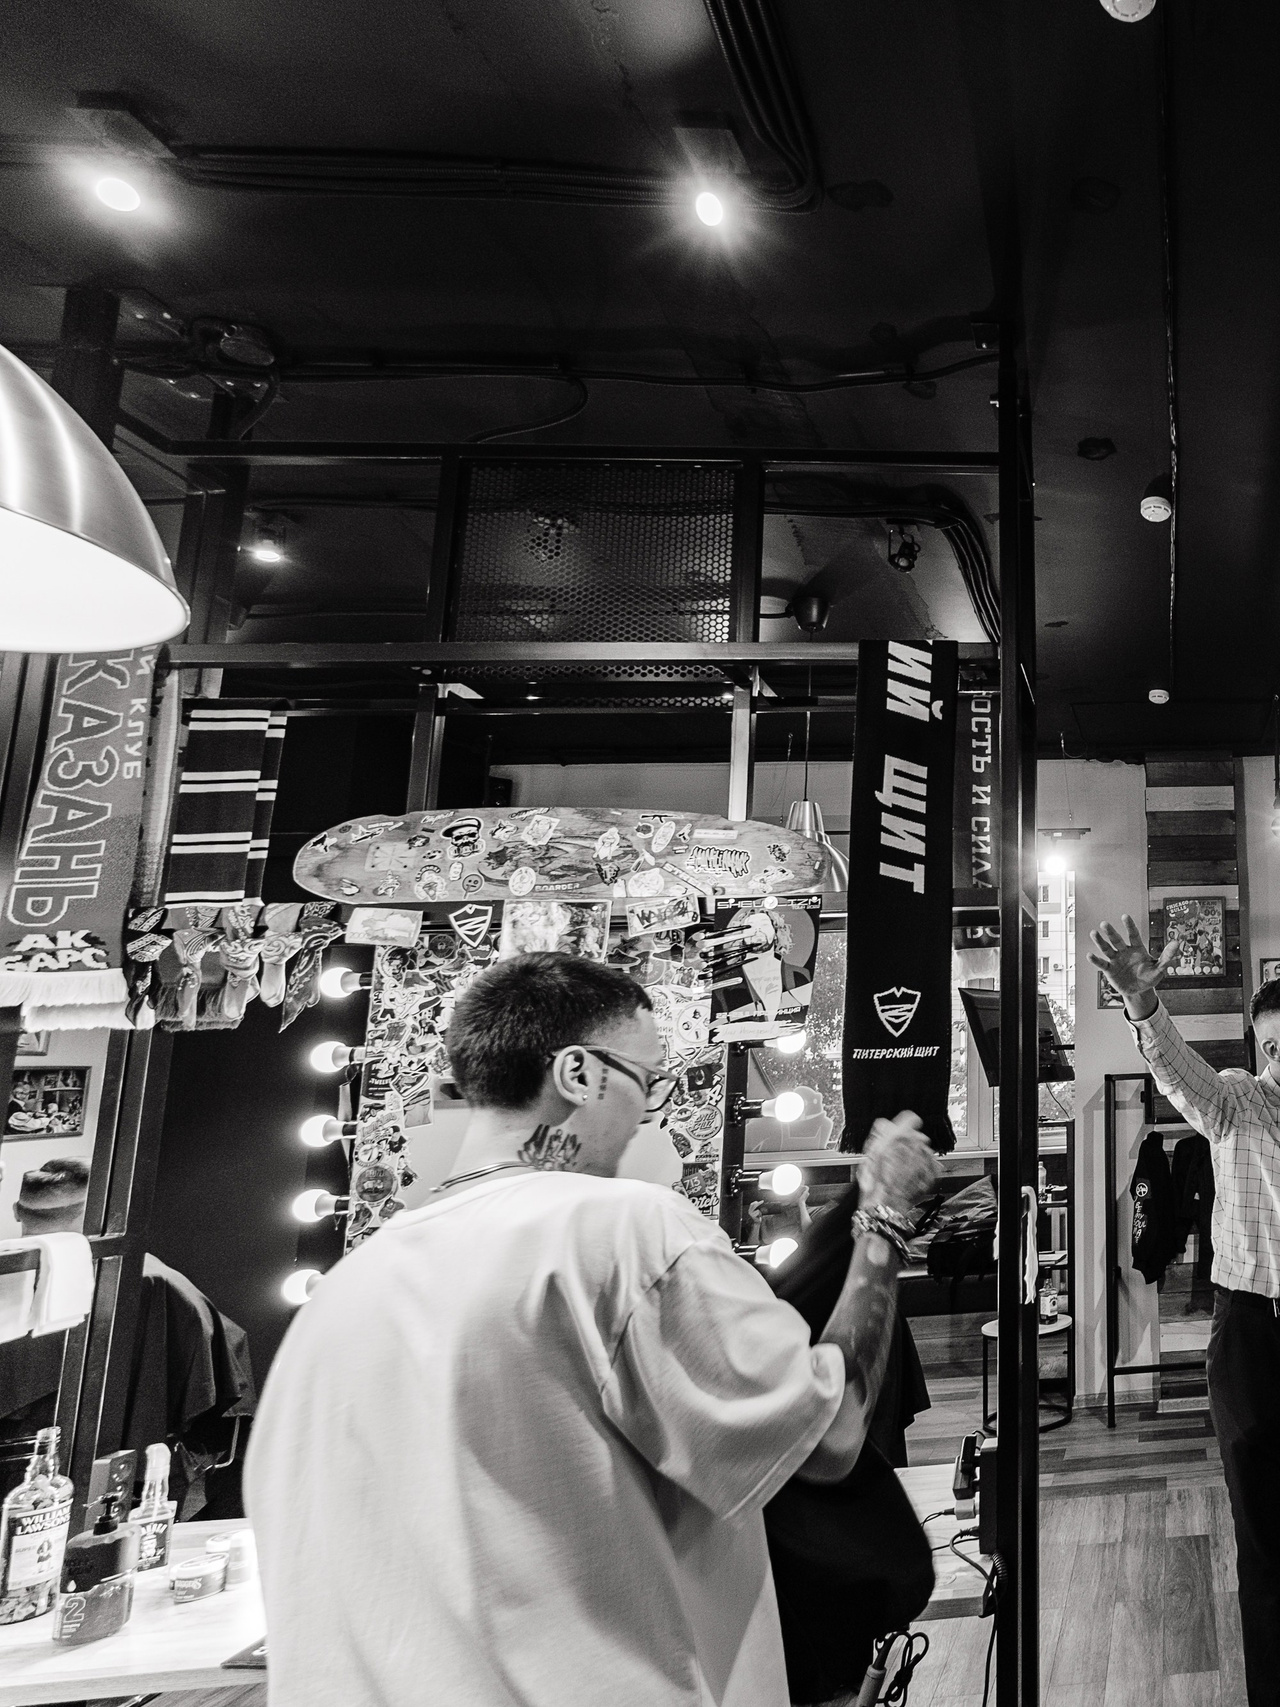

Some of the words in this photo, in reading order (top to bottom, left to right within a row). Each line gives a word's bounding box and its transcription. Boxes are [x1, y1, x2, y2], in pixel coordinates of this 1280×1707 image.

[886, 639, 944, 722] ИЙ
[7, 649, 135, 926] КАЗАНЬ
[971, 785, 992, 806] И
[875, 754, 928, 894] ЩИТ
[534, 882, 580, 891] BOARDER
[13, 929, 93, 952] АК
[852, 1044, 915, 1060] ПИТЕРСКИЙ
[913, 1046, 940, 1058] ЩИТ
[63, 1596, 87, 1623] 2
